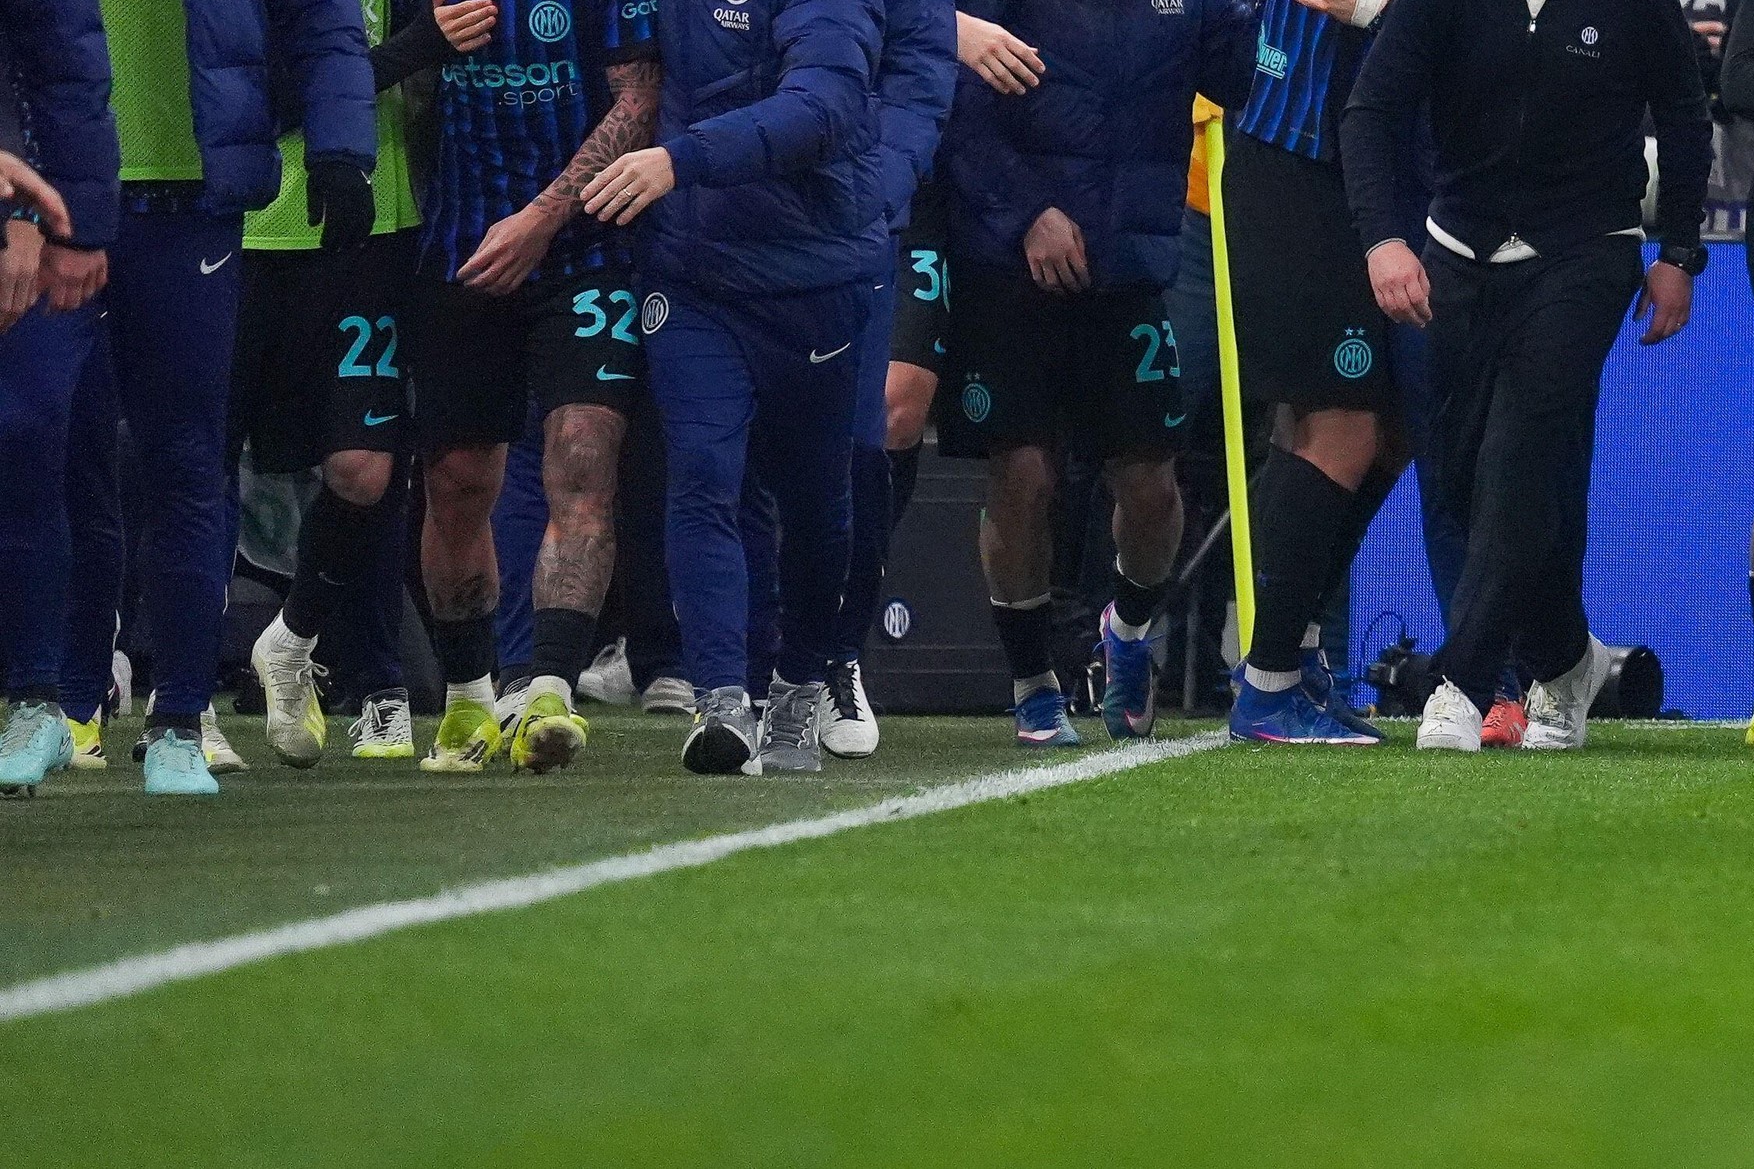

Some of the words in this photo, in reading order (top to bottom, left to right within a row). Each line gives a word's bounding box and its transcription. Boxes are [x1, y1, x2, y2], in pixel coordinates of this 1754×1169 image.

[713, 8, 750, 24] QATAR
[720, 20, 750, 31] AIRWAYS
[572, 289, 639, 346] 32
[338, 315, 399, 378] 22
